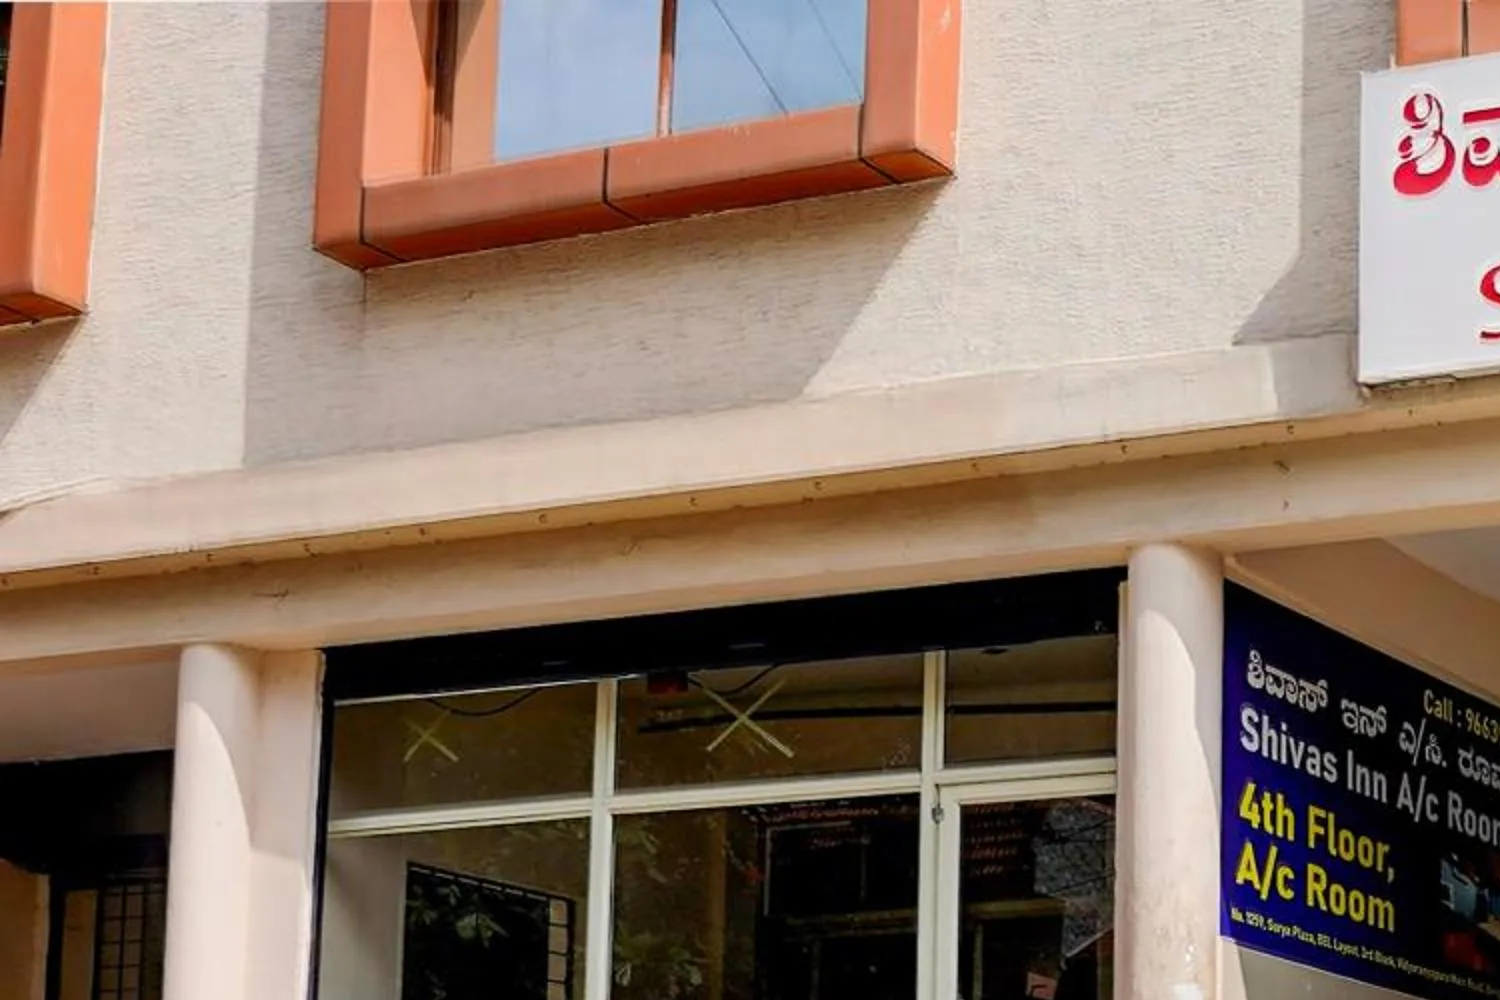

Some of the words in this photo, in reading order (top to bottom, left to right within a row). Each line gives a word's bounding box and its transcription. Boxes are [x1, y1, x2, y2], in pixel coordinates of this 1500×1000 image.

[1246, 648, 1330, 714] ಶಿವಾಸ್
[1424, 689, 1453, 725] Call
[1241, 708, 1339, 784] Shivas
[1347, 749, 1388, 804] Inn
[1397, 771, 1440, 824] A/c
[1238, 781, 1296, 842] 4th
[1307, 804, 1396, 884] Floor,
[1234, 840, 1295, 901] A/c
[1306, 862, 1396, 933] Room
